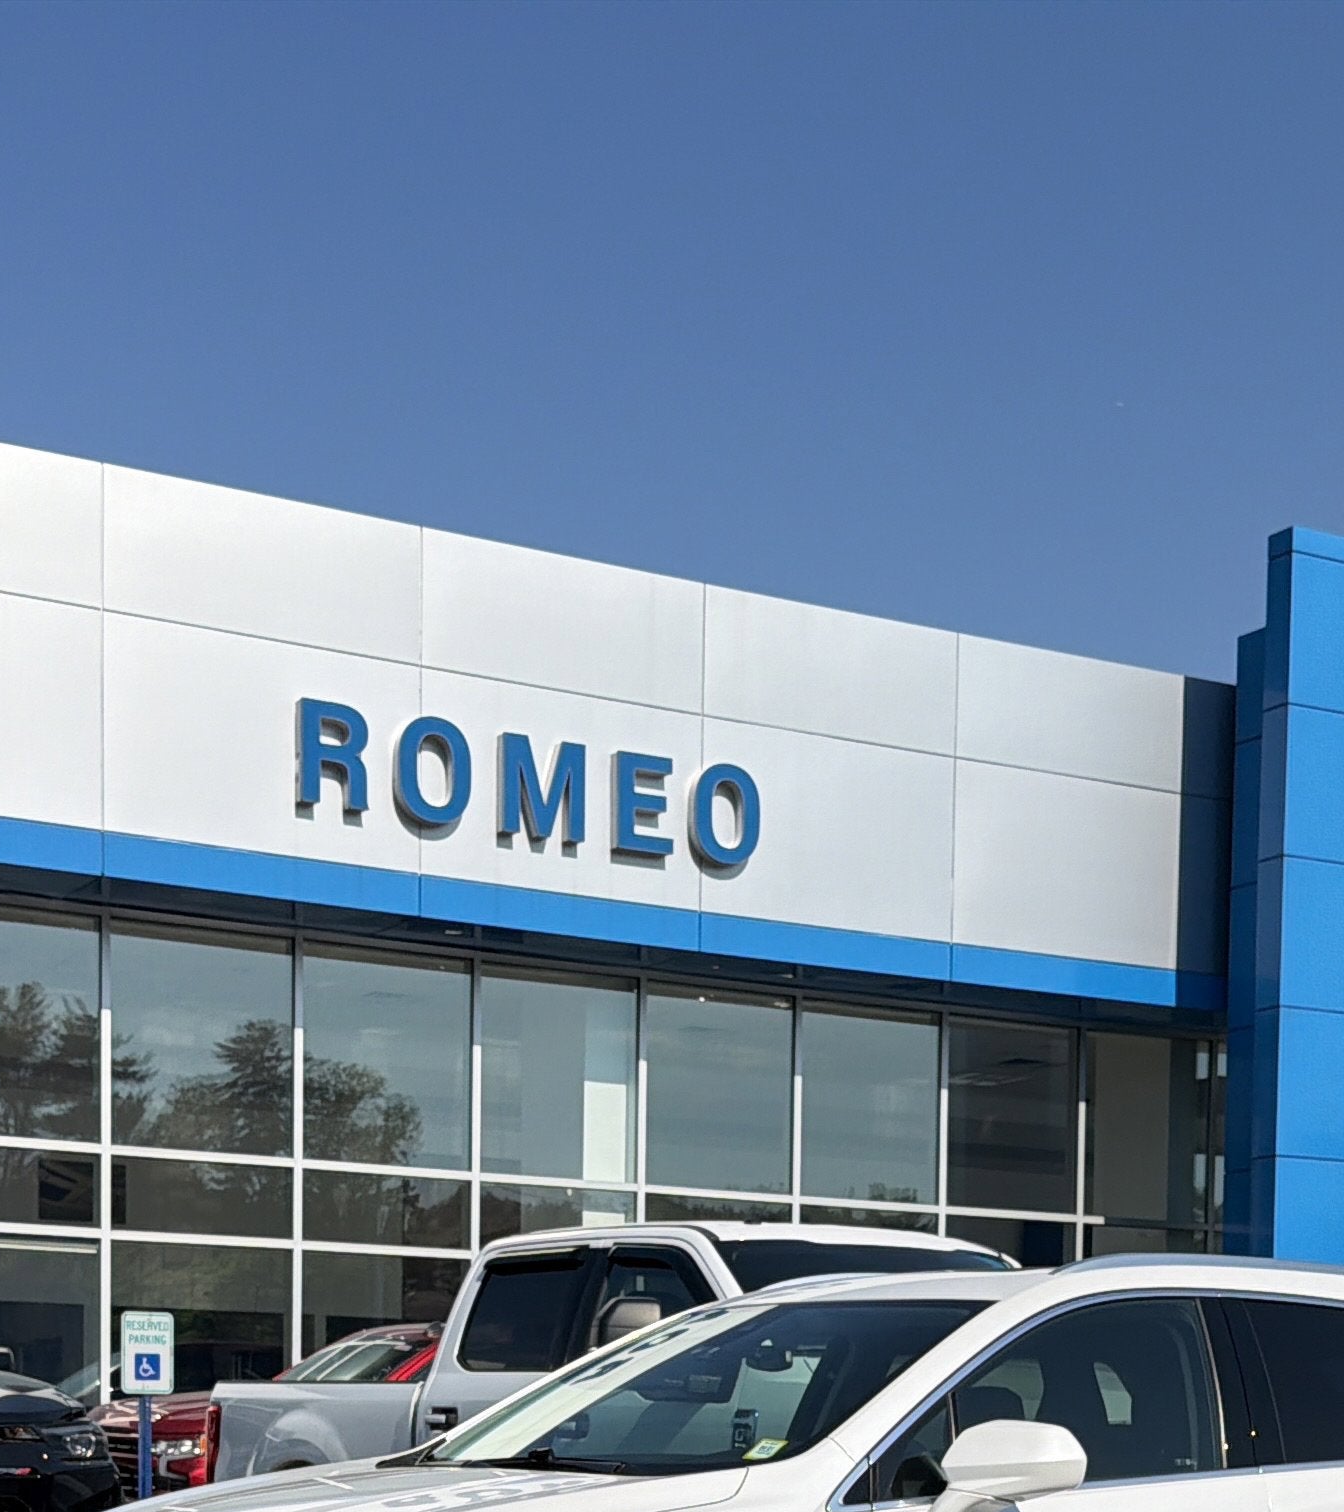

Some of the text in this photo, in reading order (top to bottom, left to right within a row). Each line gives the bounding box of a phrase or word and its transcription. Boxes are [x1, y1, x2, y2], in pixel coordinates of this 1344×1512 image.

[295, 697, 761, 867] ROMEO
[126, 1320, 169, 1331] RESERVED
[128, 1334, 167, 1345] PARKING
